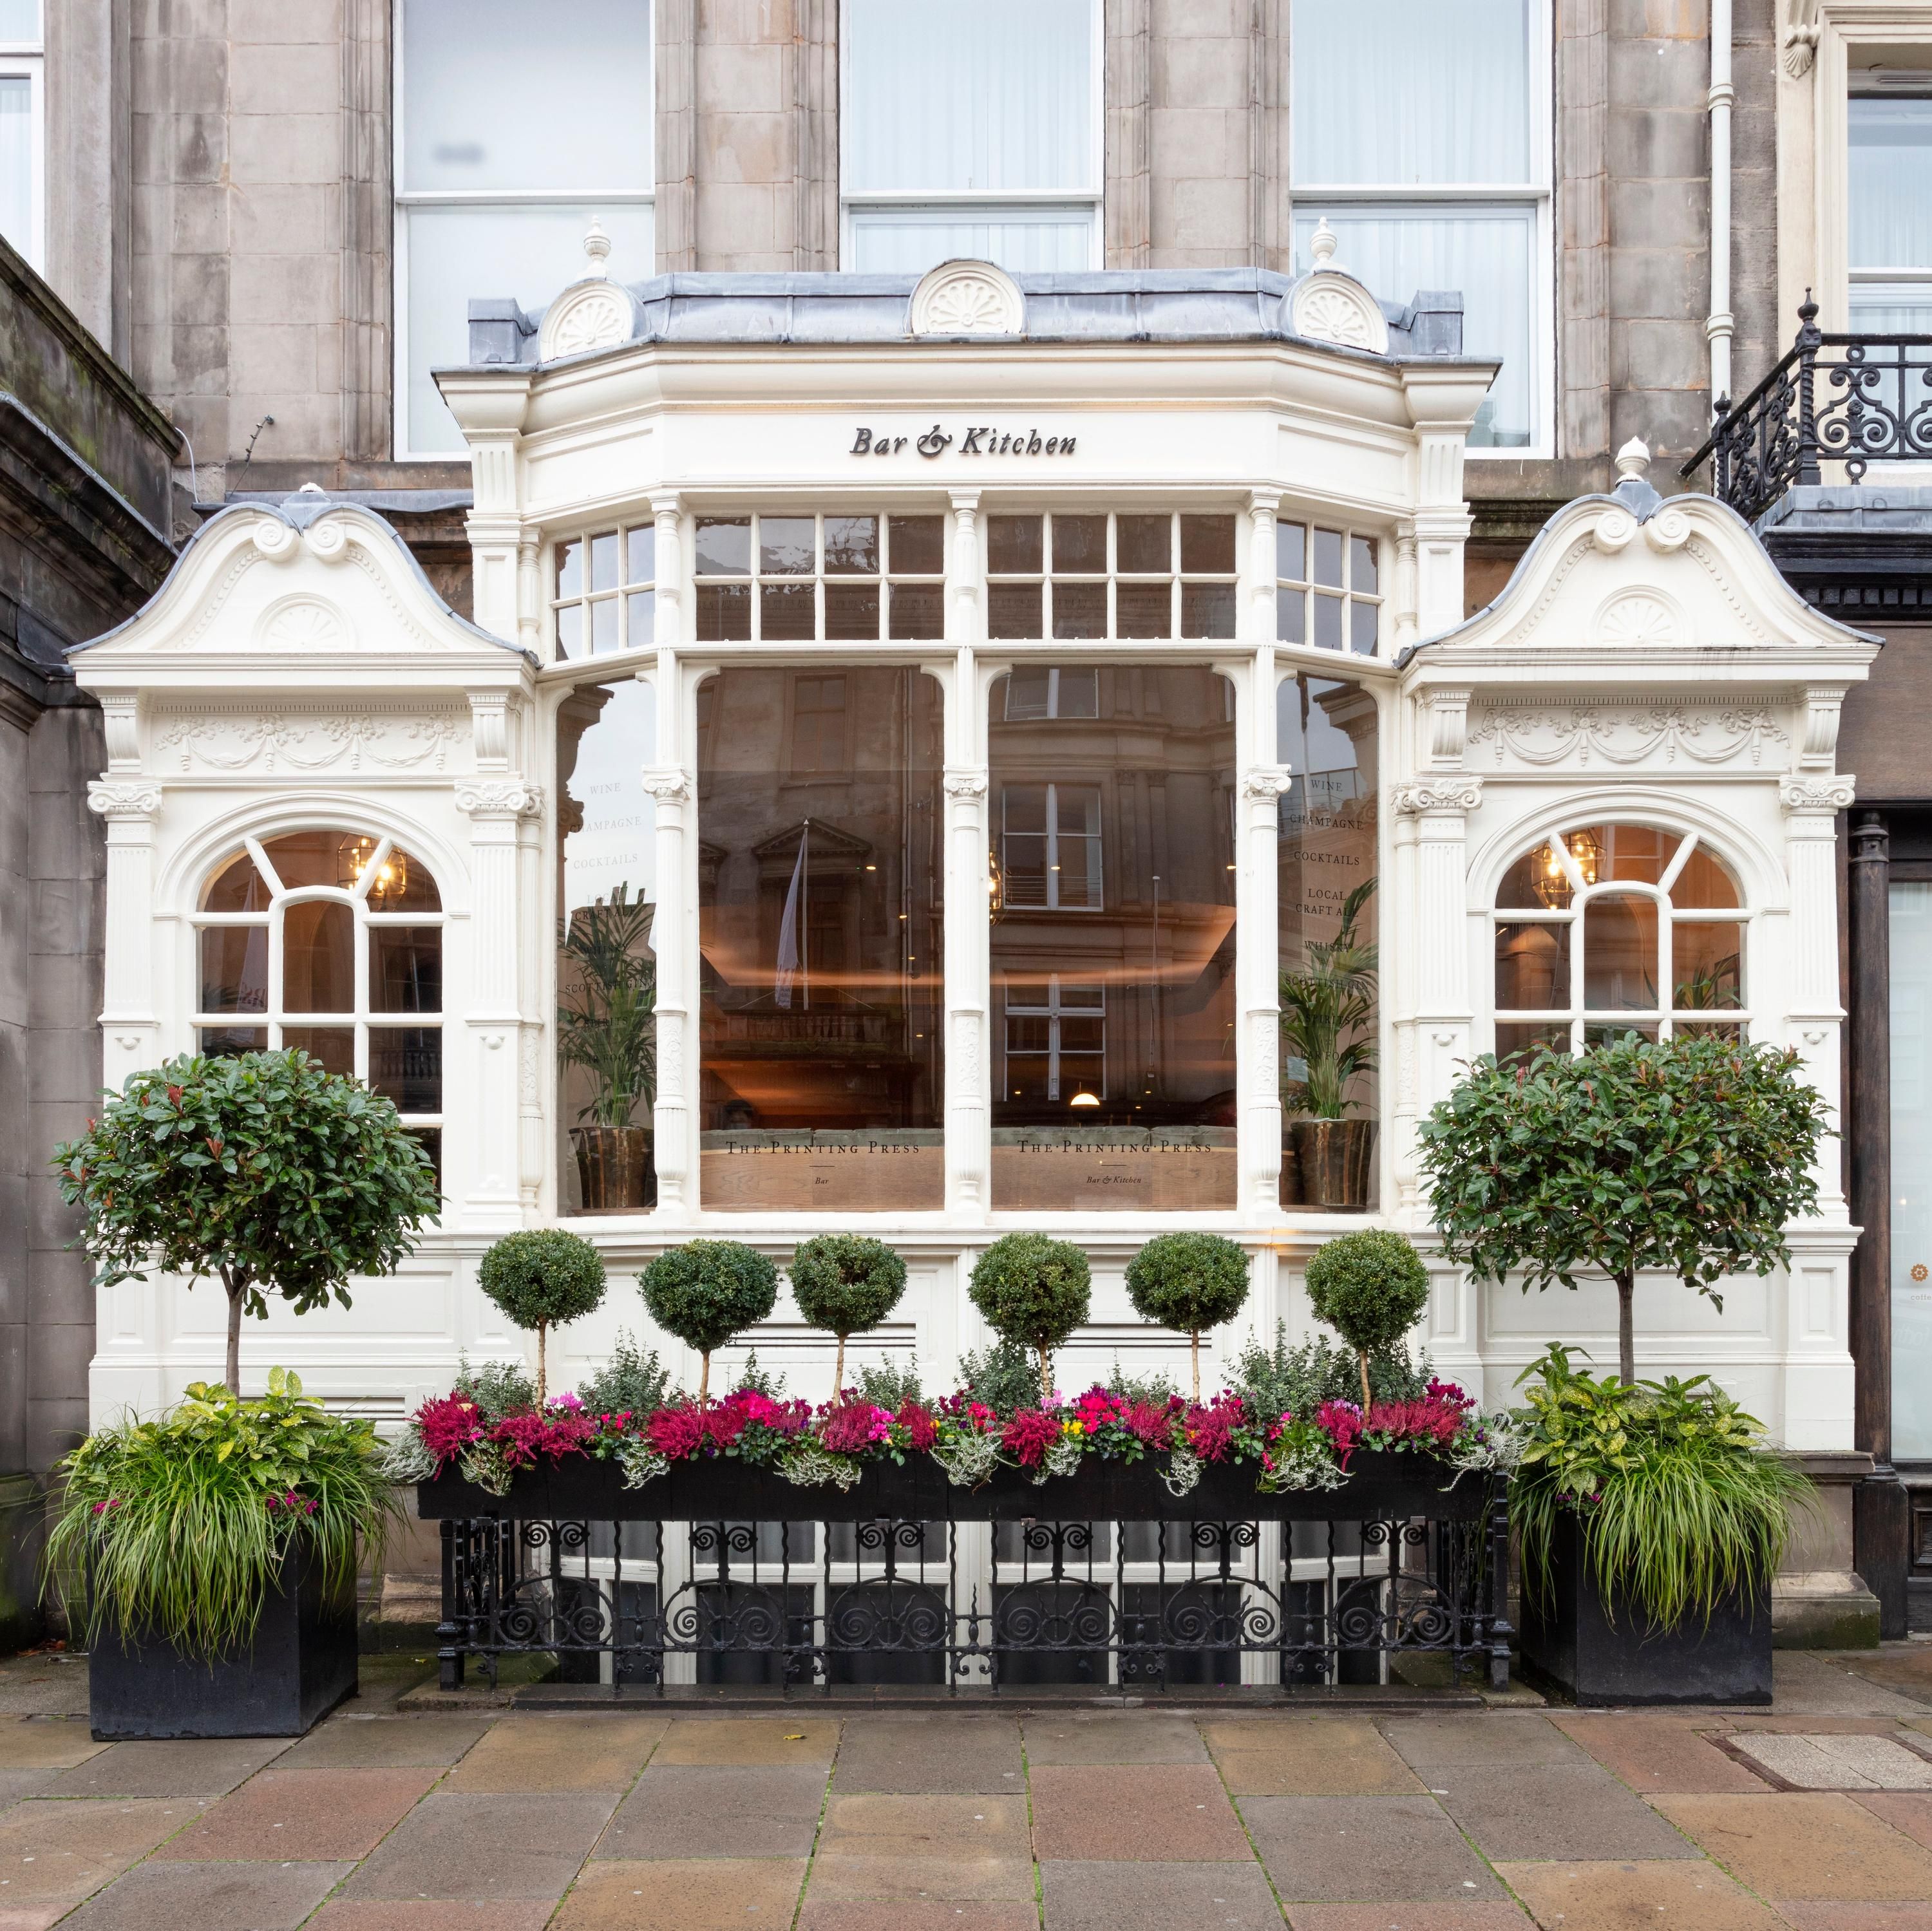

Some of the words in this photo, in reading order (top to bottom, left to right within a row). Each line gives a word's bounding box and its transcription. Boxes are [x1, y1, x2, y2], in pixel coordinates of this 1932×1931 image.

[849, 428, 907, 455] Bar
[917, 425, 952, 458] &
[958, 428, 1077, 455] Kitchen
[589, 782, 621, 795] WINE
[1311, 779, 1343, 792] WINE
[570, 816, 642, 833] CHAMPAGNE
[1290, 814, 1364, 830] CHAMPAGNE
[574, 853, 638, 869] COCKTAILS
[1294, 851, 1360, 865] COCKTAILS
[1308, 889, 1347, 901] LOCAL
[575, 909, 610, 921] CRAFT
[1296, 903, 1332, 915] CRAFT
[1305, 940, 1351, 953] WHISKY
[565, 980, 621, 994] SCOTTISH
[1285, 975, 1343, 989] SCOTTISH
[770, 1141, 858, 1154] PRINTING
[867, 1140, 920, 1154] PRESS
[1062, 1140, 1150, 1153] PRINTING
[1159, 1140, 1211, 1153] PRESS
[1103, 1175, 1112, 1184] &
